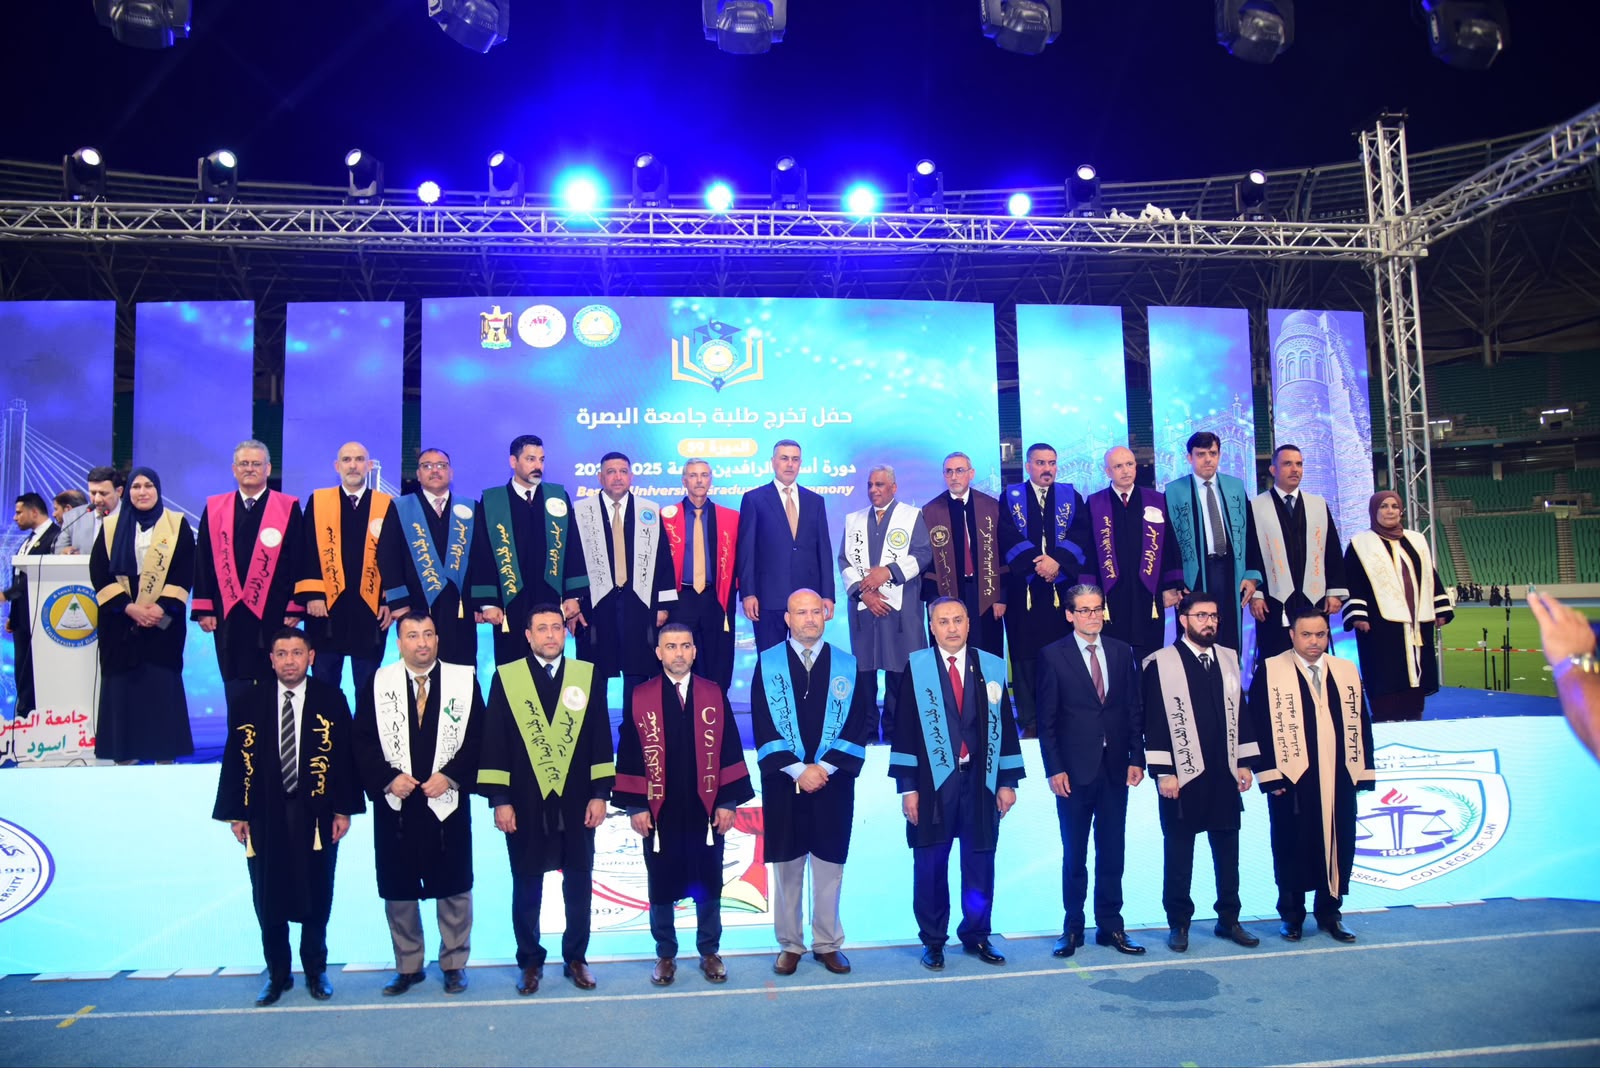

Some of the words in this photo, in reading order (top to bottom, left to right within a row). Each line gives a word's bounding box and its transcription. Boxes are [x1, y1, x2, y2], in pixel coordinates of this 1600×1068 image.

[576, 407, 638, 430] البصرة
[643, 407, 707, 428] جامعة
[712, 407, 759, 427] طلبة
[763, 407, 807, 430] تخرج
[812, 407, 853, 428] حفل
[574, 463, 601, 476] 202
[823, 459, 857, 477] دورة
[326, 526, 336, 544] عميد
[453, 520, 468, 545] مجلس
[550, 521, 562, 548] مجلس
[985, 516, 993, 531] عميد
[980, 529, 993, 543] كلية
[1145, 525, 1159, 550] مجلس
[256, 549, 271, 578] مجلس
[324, 547, 336, 564] كلية
[450, 544, 464, 570] الجامعة
[548, 549, 559, 576] الجامعة
[984, 544, 993, 560] التربية
[1143, 550, 1156, 575] الجامعة
[247, 578, 264, 606] الجامعة
[983, 576, 995, 595] الصرفة
[524, 700, 540, 716] عميد
[925, 688, 938, 706] عميد
[1345, 686, 1358, 719] مجلس
[0, 713, 40, 736] البصر
[45, 710, 88, 728] جامعة
[560, 711, 576, 743] مجلس
[638, 712, 660, 742] عميد
[925, 708, 940, 724] كلية
[988, 709, 999, 740] مجلس
[1171, 713, 1187, 726] كلية
[1276, 712, 1285, 733] كلية
[312, 713, 334, 752] مجلس
[526, 720, 543, 736] كلية
[27, 734, 66, 758] اسود
[1277, 737, 1289, 763] التربية
[1347, 725, 1361, 762] الكلية
[1178, 749, 1199, 774] البيطري
[310, 756, 330, 797] الجامعة
[1380, 848, 1417, 857] 1964
[1410, 851, 1474, 882] COLLEGE
[1471, 841, 1486, 854] OF
[1481, 823, 1497, 842] LAW
